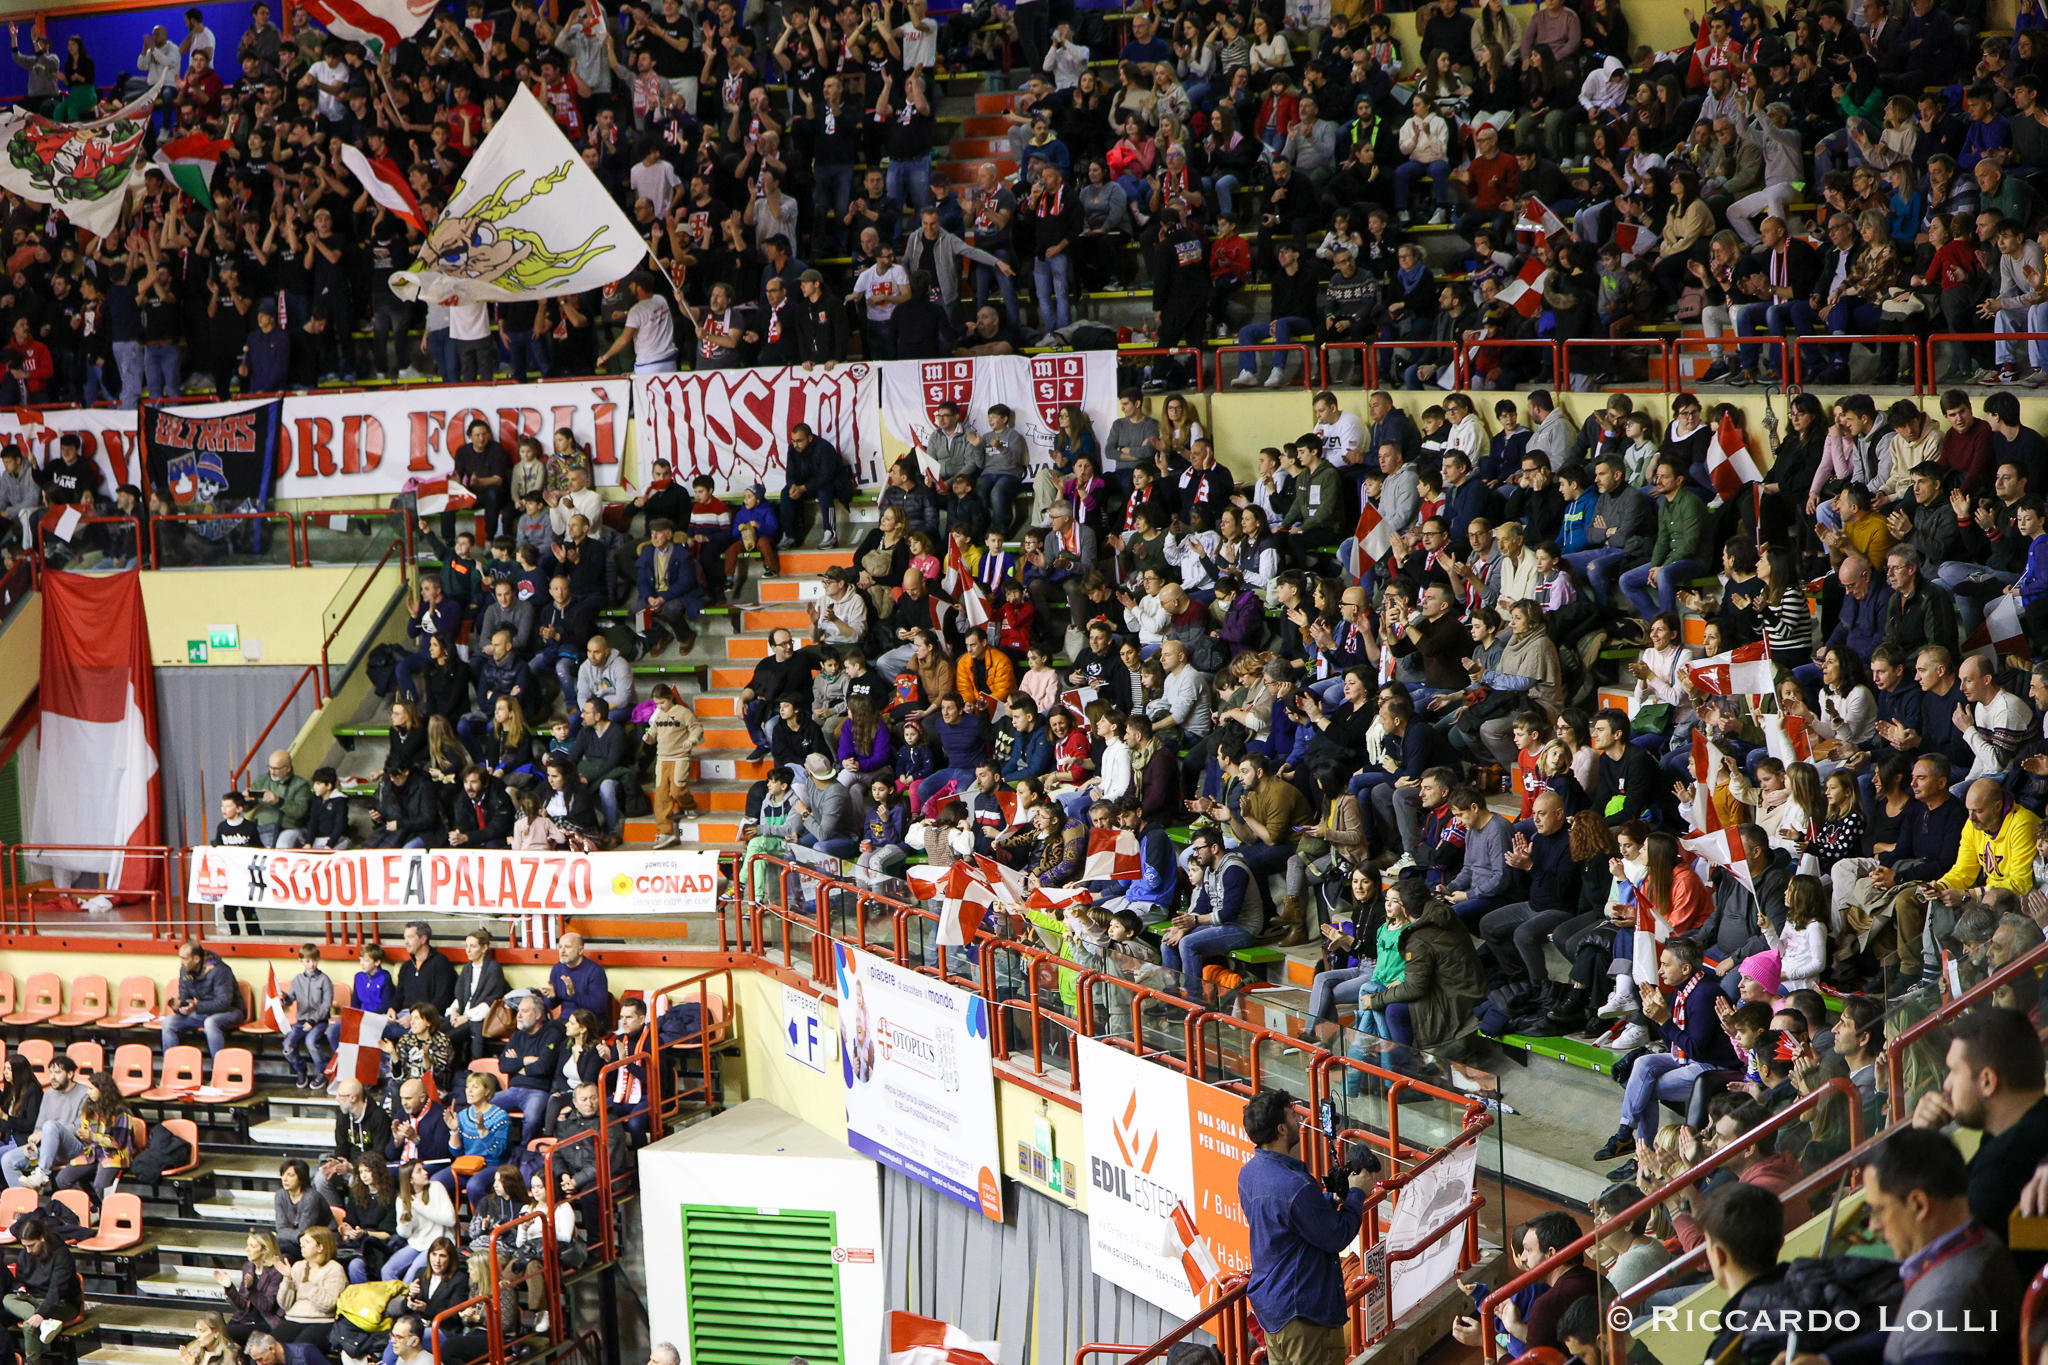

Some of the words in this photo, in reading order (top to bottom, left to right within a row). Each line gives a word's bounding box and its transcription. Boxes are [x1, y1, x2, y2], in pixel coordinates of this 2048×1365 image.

[155, 412, 256, 452] ULTRAS
[715, 764, 720, 774] C
[645, 860, 670, 870] powered
[671, 861, 678, 869] by
[247, 854, 593, 910] #SCUOLEAPALAZZO
[636, 874, 714, 894] CONAD
[633, 897, 662, 907] Persone
[685, 896, 692, 905] le
[870, 965, 896, 987] piacere
[787, 991, 817, 1015] PARTERRE
[807, 1015, 818, 1062] F
[893, 1029, 936, 1064] OTOPLUS
[1197, 1110, 1214, 1129] UNA
[1216, 1117, 1236, 1138] SOLA
[1238, 1127, 1257, 1146] AZ
[1199, 1132, 1214, 1151] PER
[1216, 1139, 1239, 1161] TANTI
[1091, 1154, 1132, 1203] EDIL
[1217, 1242, 1252, 1273] Habi
